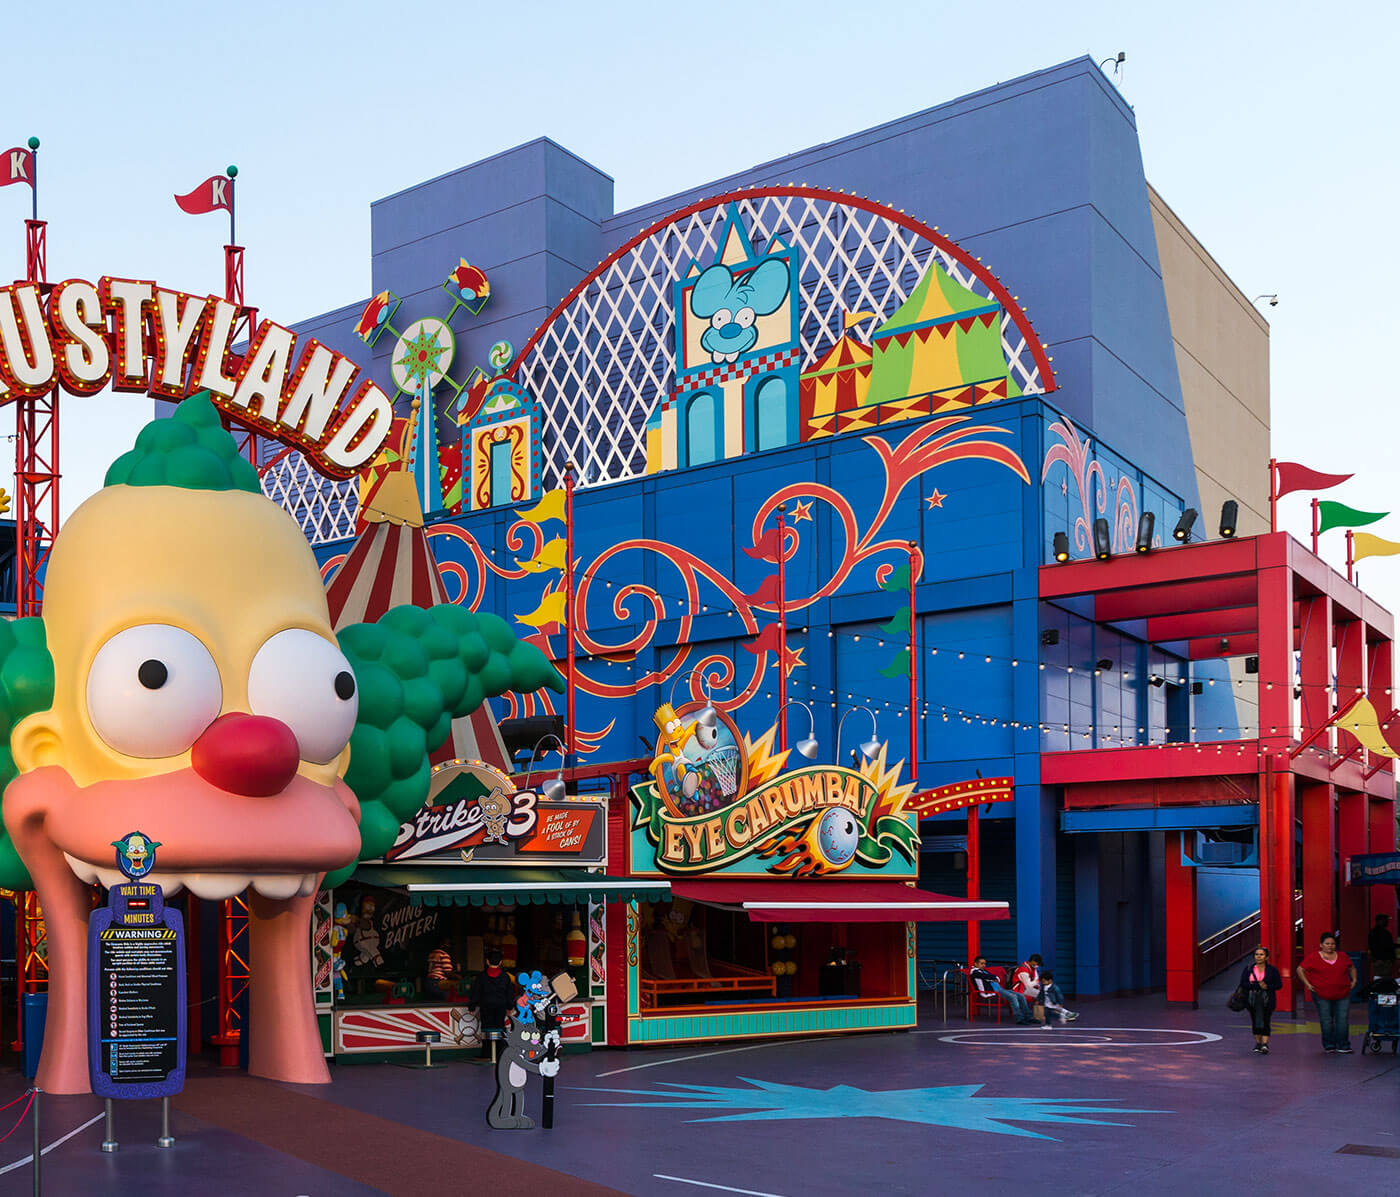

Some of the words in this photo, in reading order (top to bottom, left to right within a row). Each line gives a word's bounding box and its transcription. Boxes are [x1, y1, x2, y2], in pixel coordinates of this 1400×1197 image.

[9, 151, 28, 180] K
[211, 178, 228, 207] K
[506, 791, 538, 837] 3
[546, 821, 564, 834] FOOL
[572, 819, 581, 827] BY
[662, 822, 727, 863] EYE
[726, 772, 871, 848] CARUMBA!
[559, 834, 582, 848] CANS!
[120, 886, 137, 896] WAIT
[139, 886, 156, 896] TIME
[123, 913, 154, 924] MINUTES
[381, 902, 423, 931] SWING
[384, 911, 439, 949] BATTER!
[115, 930, 162, 939] WARNING
